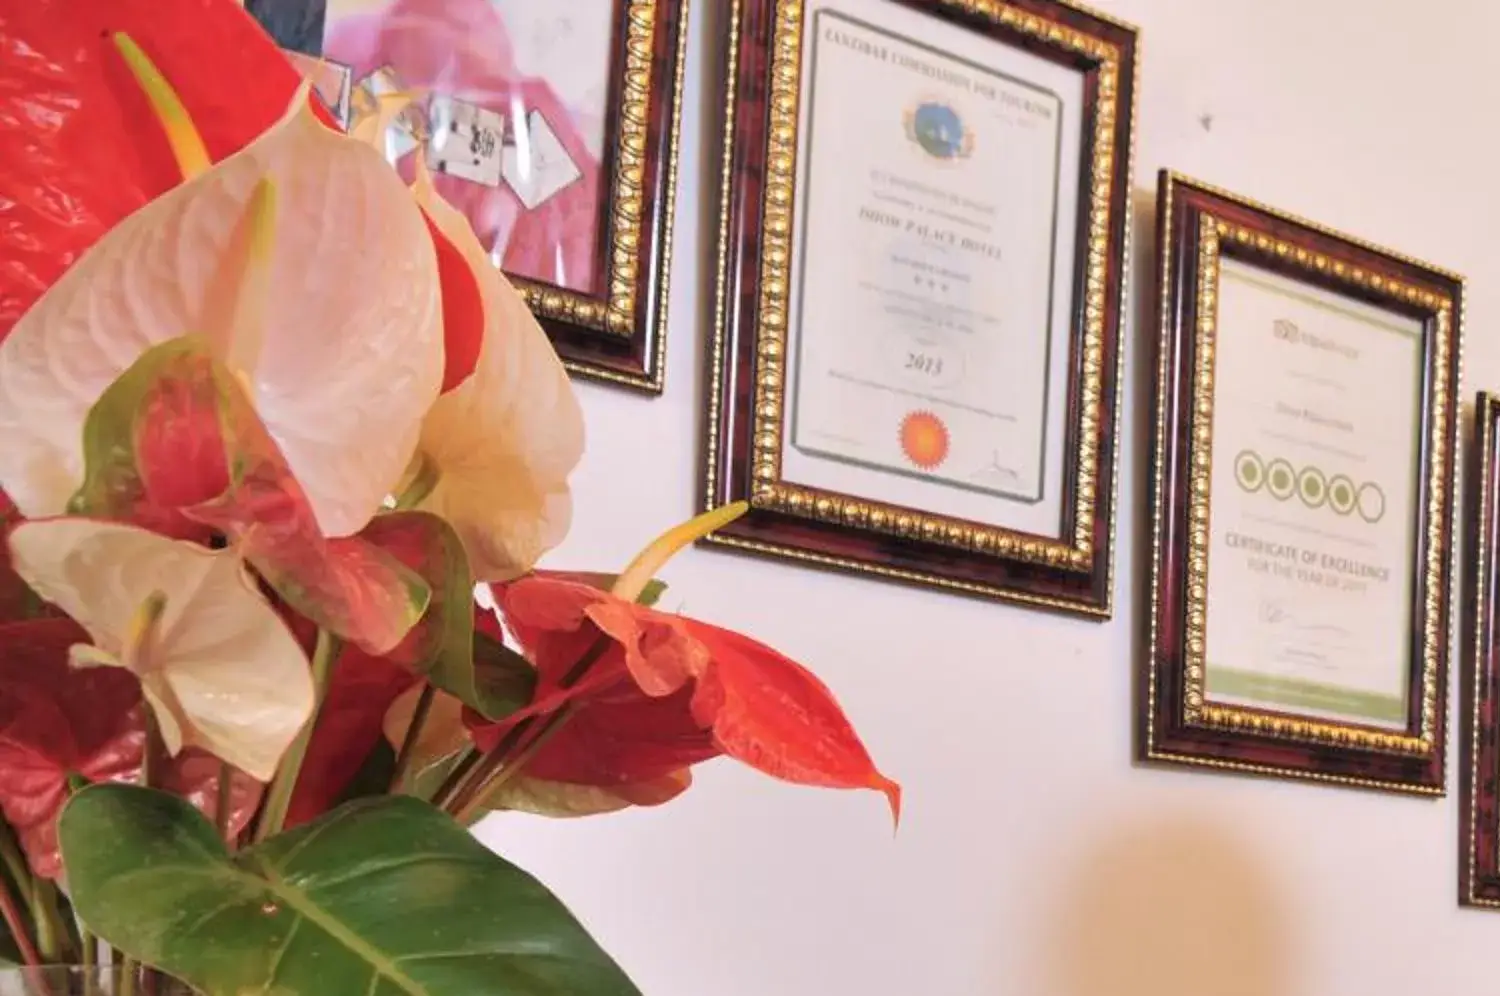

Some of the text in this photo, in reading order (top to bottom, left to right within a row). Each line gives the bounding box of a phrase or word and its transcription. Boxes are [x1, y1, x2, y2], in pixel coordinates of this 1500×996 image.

[973, 79, 997, 100] FOR
[1225, 530, 1298, 564] CERTIFICATE
[1301, 549, 1318, 565] OF
[1321, 554, 1391, 582] EXCELLENCE
